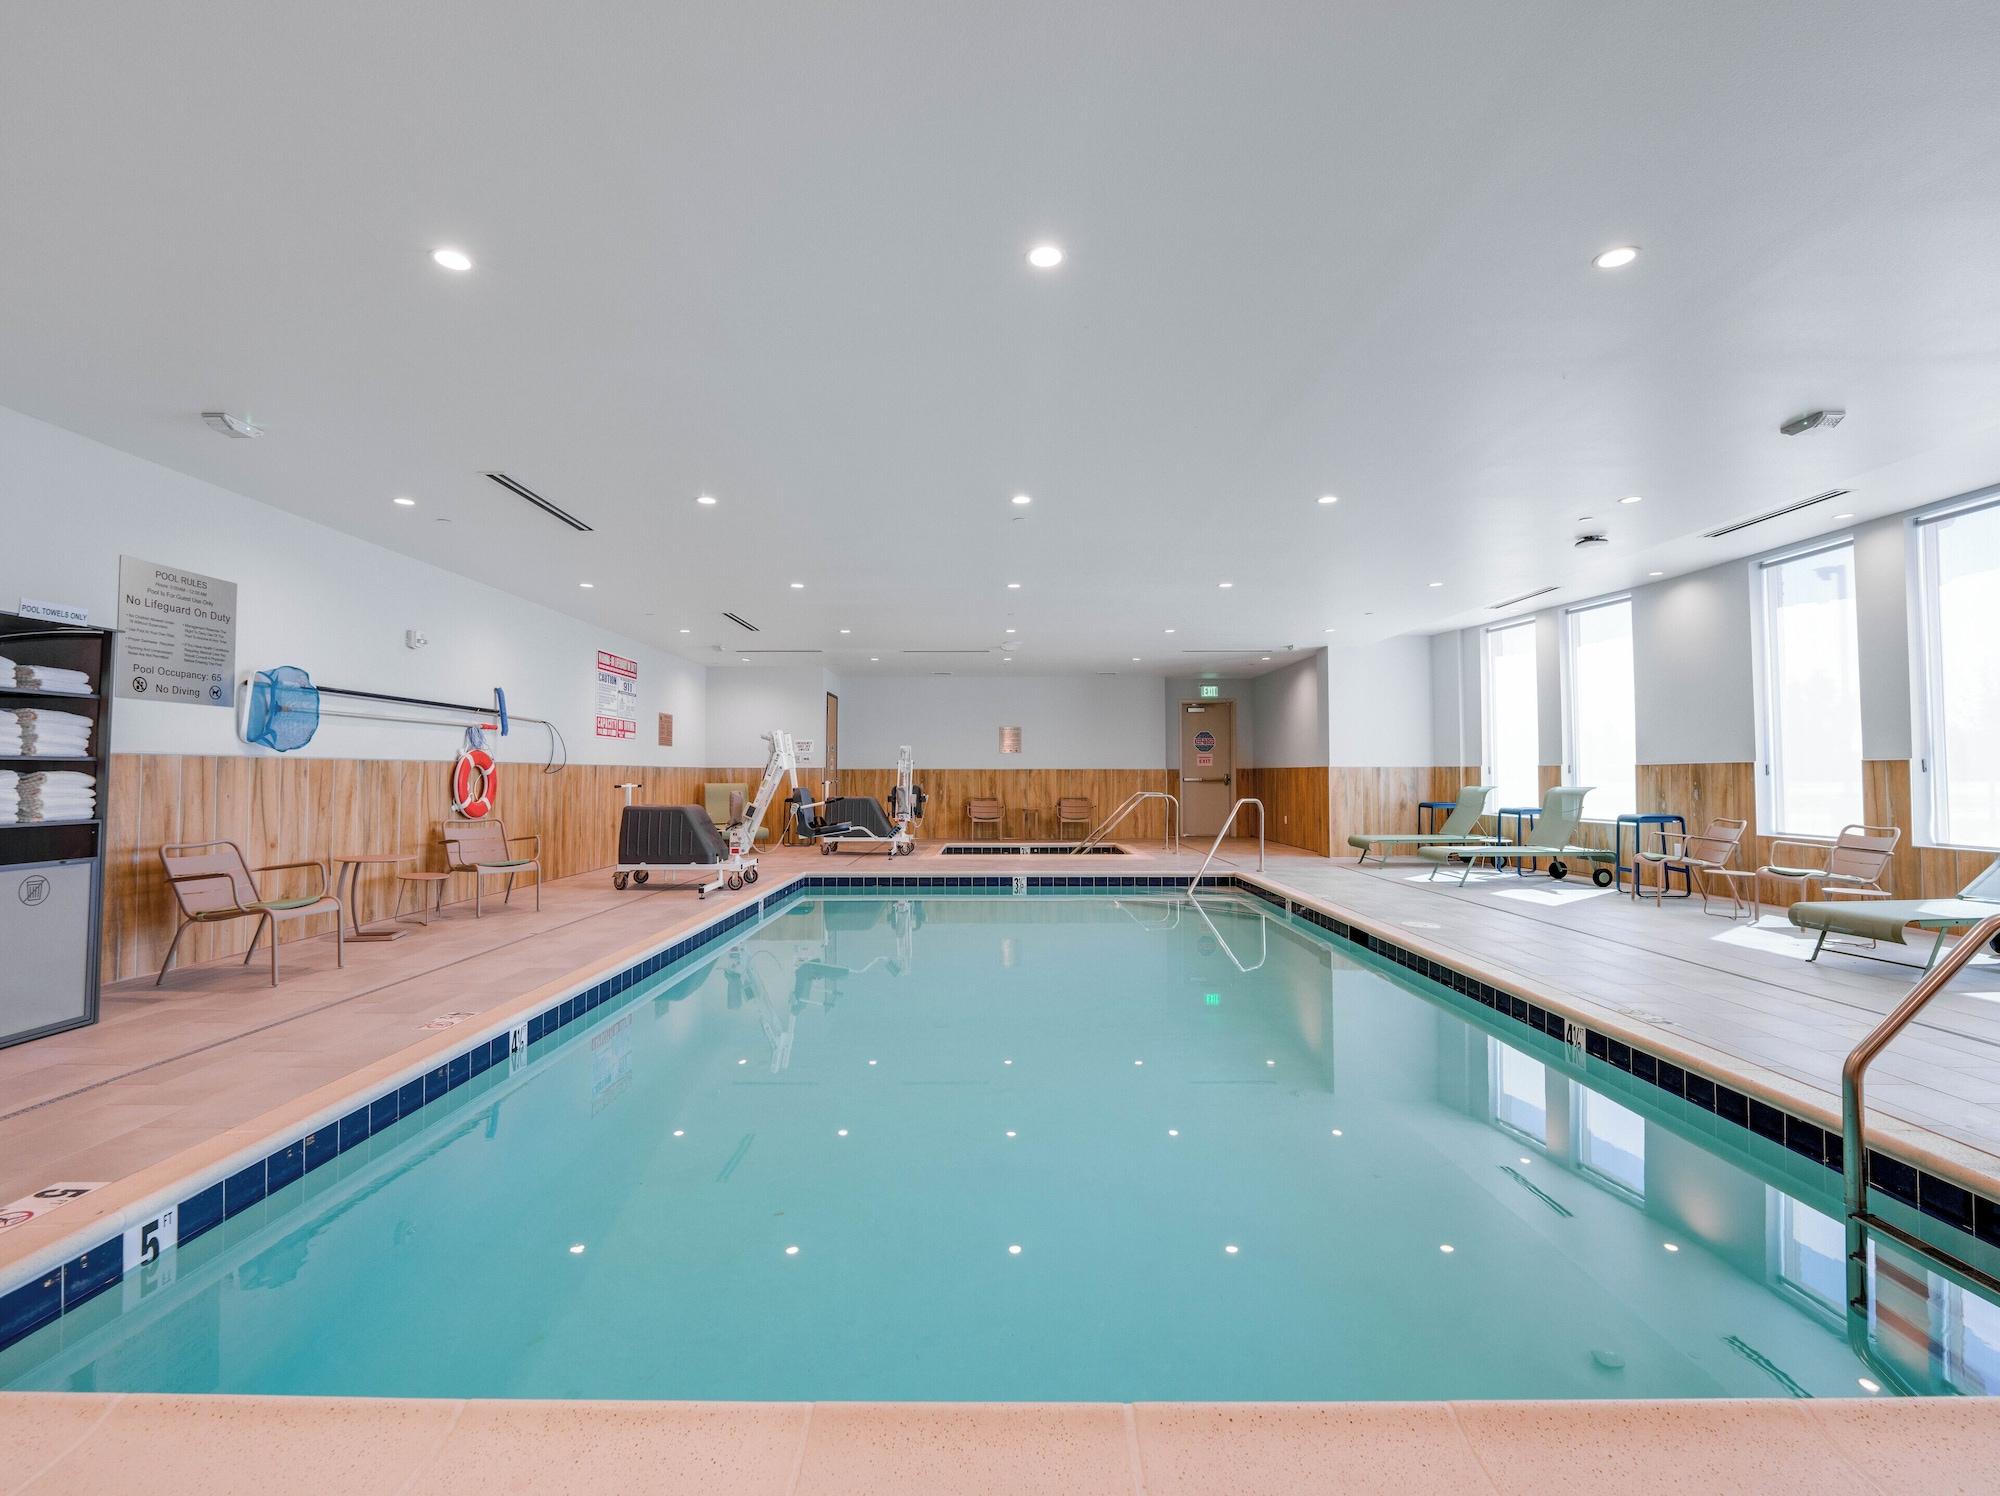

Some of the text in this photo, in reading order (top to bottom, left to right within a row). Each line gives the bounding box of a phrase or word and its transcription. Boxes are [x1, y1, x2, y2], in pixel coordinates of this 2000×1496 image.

[155, 570, 177, 583] POOL
[181, 576, 208, 589] RULES
[21, 604, 87, 621] POOL TOWELS ONLY
[126, 594, 231, 625] No Lifeguard On Duty
[133, 663, 222, 682] Pool Occupancy: 65
[598, 672, 617, 685] CAUTION
[155, 683, 200, 699] No Diving
[623, 682, 633, 692] 911
[1203, 686, 1216, 696] EXIT
[141, 1211, 173, 1267] 5 FT
